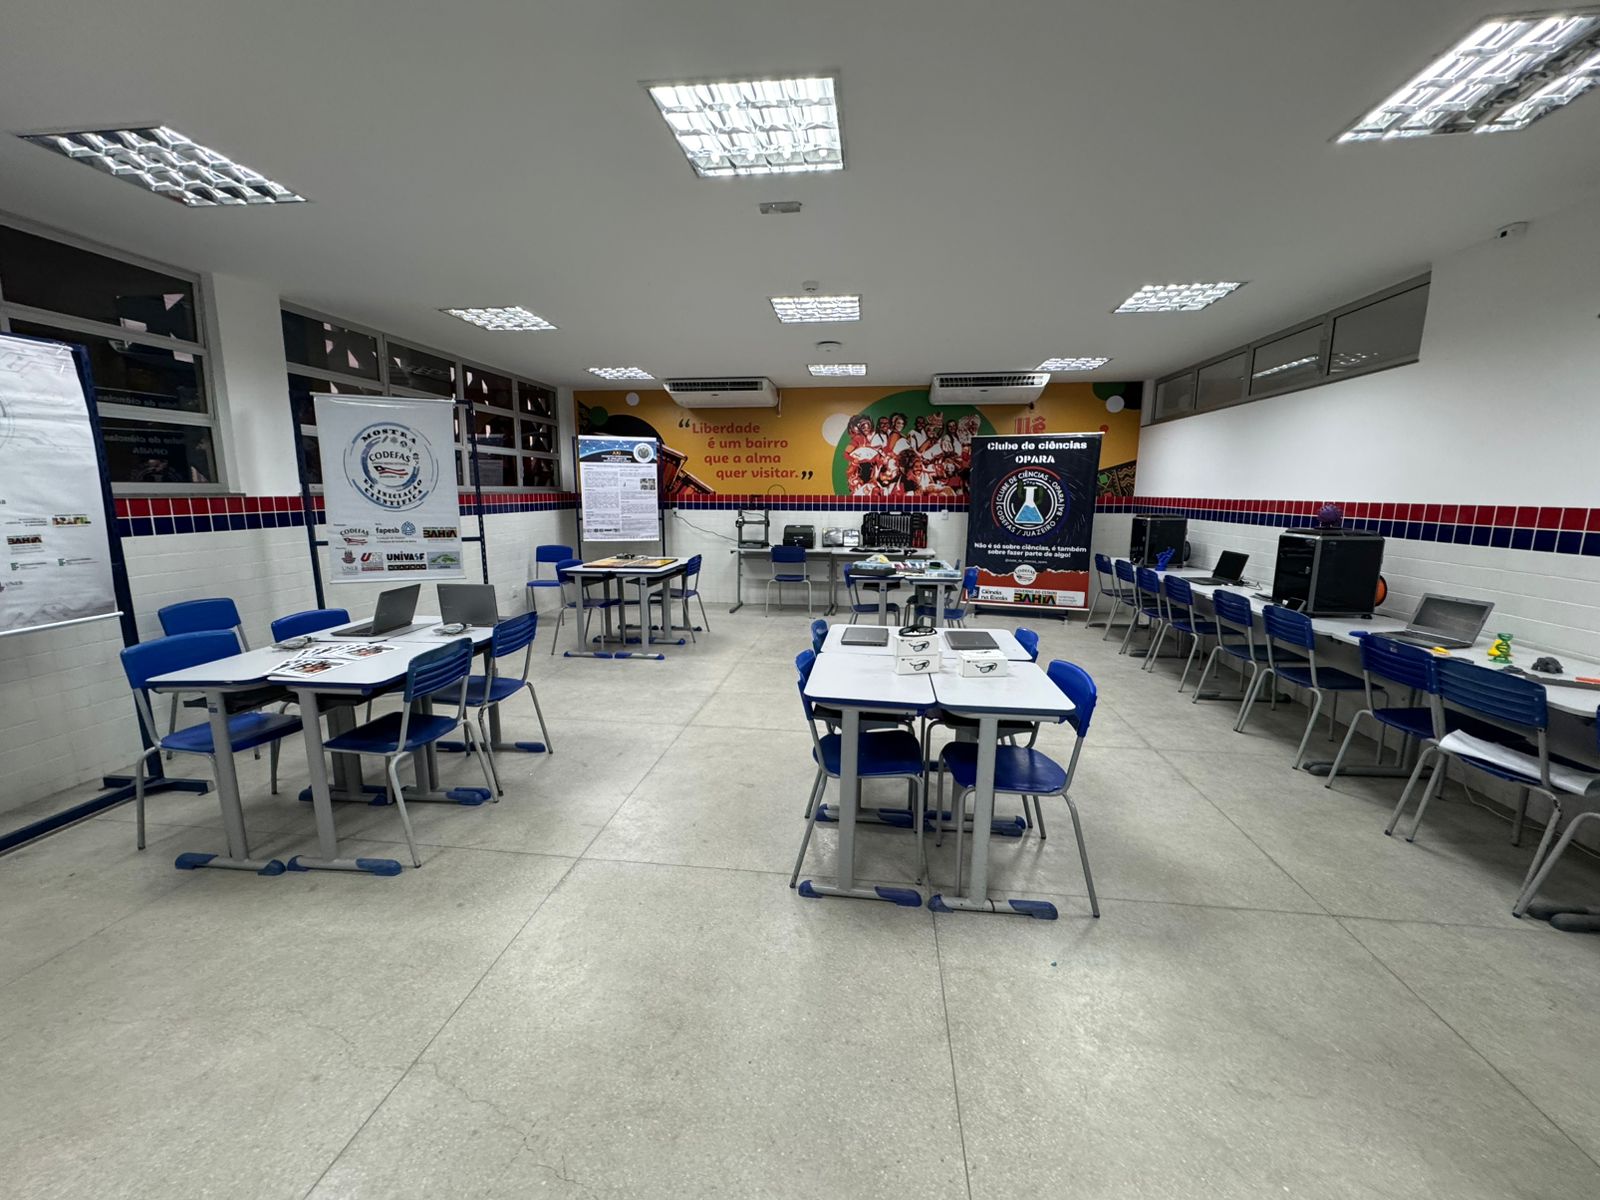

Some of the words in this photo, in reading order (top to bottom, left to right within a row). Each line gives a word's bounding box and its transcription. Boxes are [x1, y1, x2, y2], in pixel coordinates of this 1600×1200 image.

[361, 428, 417, 444] MOSTRA
[707, 436, 716, 449] é
[719, 440, 742, 449] um
[745, 436, 789, 449] bairro
[987, 441, 1019, 451] Clube
[1021, 441, 1036, 450] de
[1038, 440, 1088, 450] ciências
[368, 450, 411, 463] CODEFAS
[704, 454, 729, 466] que
[733, 454, 741, 464] a
[745, 452, 781, 464] alma
[1015, 454, 1056, 464] OPARA
[716, 469, 747, 480] quer
[996, 481, 1010, 501] CLUBE
[1008, 476, 1018, 484] DE
[1017, 470, 1049, 481] CIÊNCIAS
[1051, 481, 1065, 503] OPARA
[364, 487, 423, 506] CIENTÍFICA
[995, 505, 1017, 533] CODEFAS
[1021, 520, 1056, 537] JUAZEIRO
[376, 526, 400, 535] fapesb
[423, 530, 458, 538] BAHIA
[1021, 543, 1051, 552] ciências,
[1057, 545, 1087, 553] também
[386, 551, 425, 561] UNIVASF
[1024, 550, 1043, 558] parte
[1054, 551, 1071, 559] algo!
[1013, 592, 1057, 605] BAHIA
